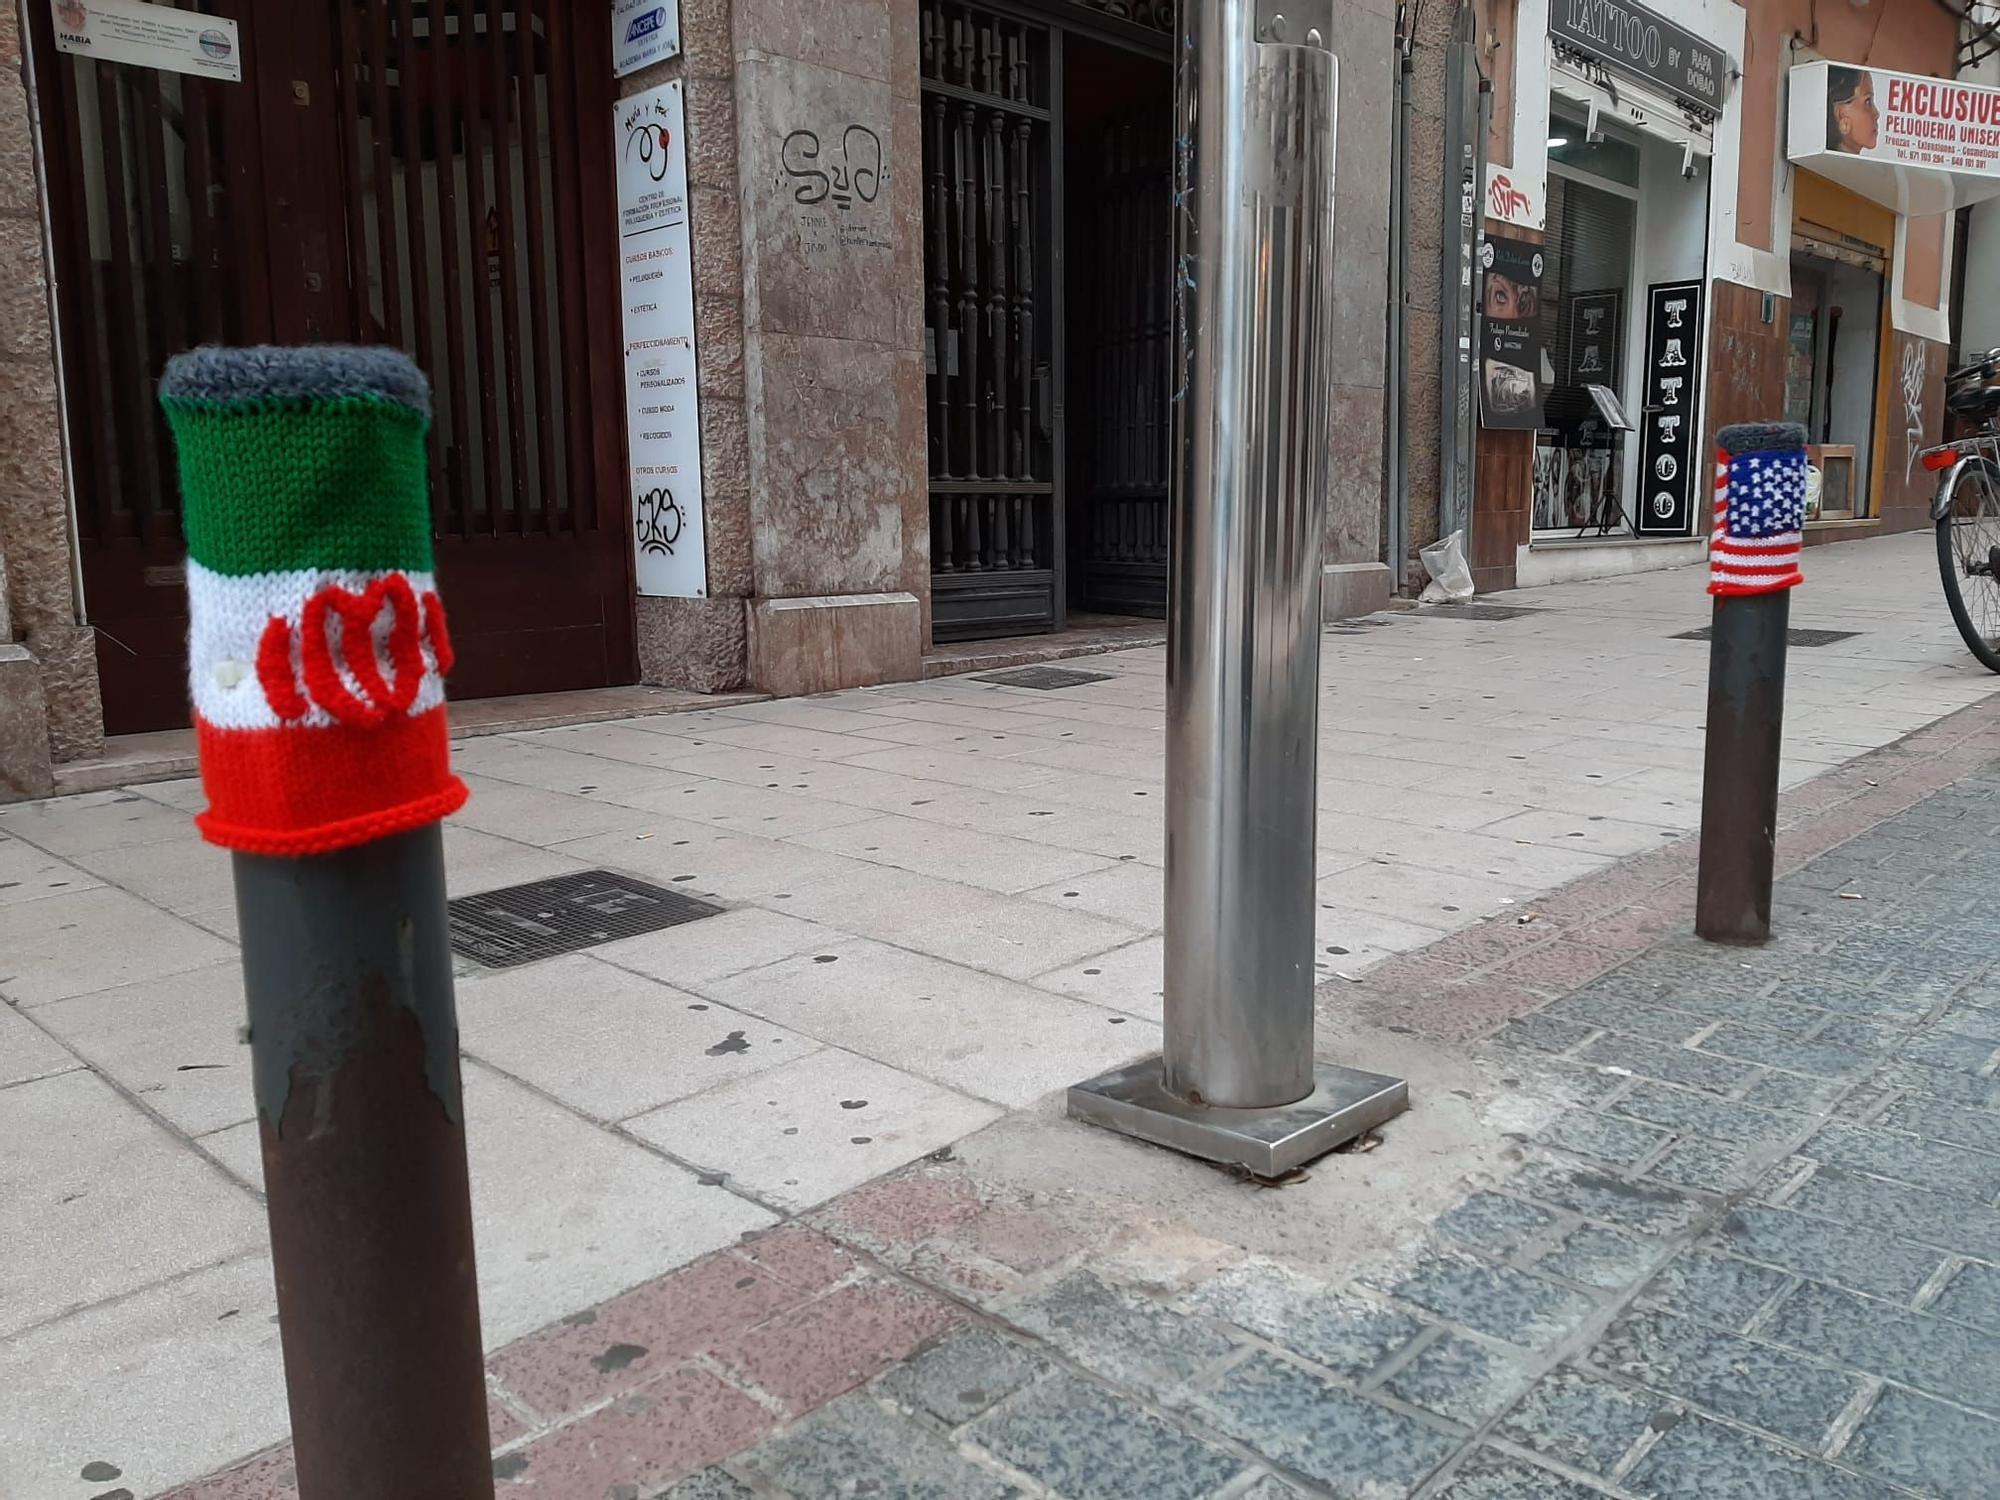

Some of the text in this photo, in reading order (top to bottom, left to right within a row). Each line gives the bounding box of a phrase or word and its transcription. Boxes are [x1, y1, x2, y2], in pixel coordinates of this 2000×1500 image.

[59, 32, 92, 46] HABIA
[1566, 0, 1681, 68] TATTOO BY
[1691, 49, 1713, 75] RAFA
[1687, 68, 1715, 97] DOBAO
[1888, 79, 2000, 126] EXCLUSIVE
[1886, 115, 1956, 142] PELUQUERIA
[640, 367, 661, 378] CURSOS
[640, 377, 686, 389] PERSONALIZADOS
[1653, 298, 1688, 520] TATTOO
[655, 465, 678, 474] CURSOS
